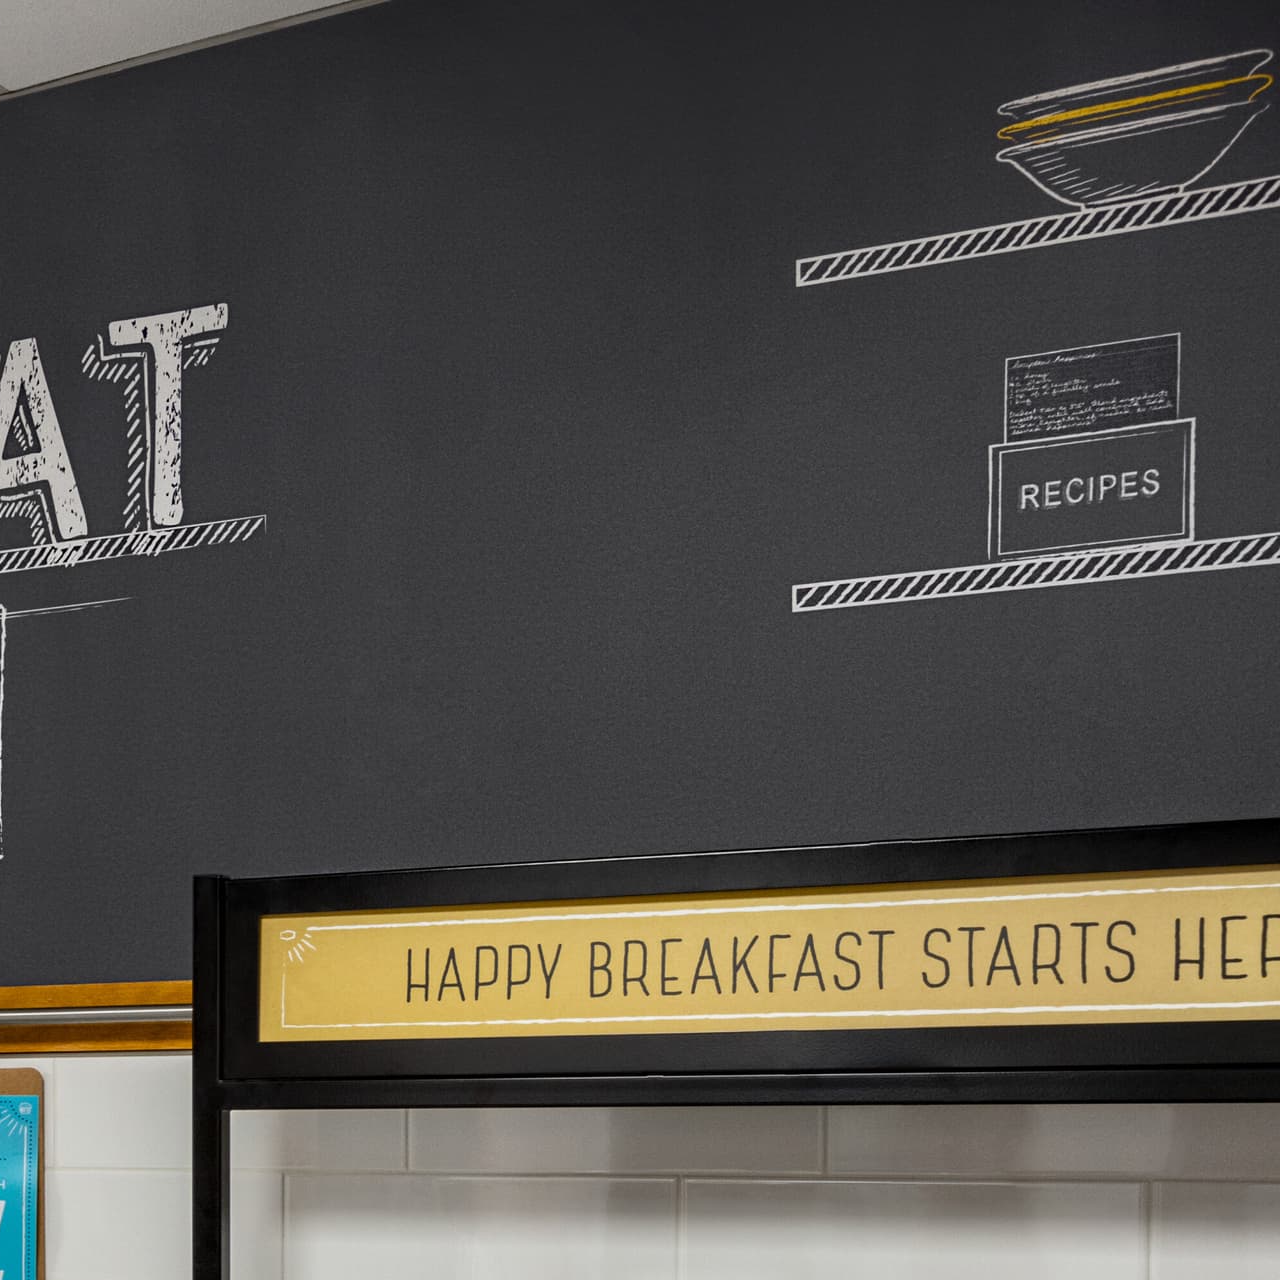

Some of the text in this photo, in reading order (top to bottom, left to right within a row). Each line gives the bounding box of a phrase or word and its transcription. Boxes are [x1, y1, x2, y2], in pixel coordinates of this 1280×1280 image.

[1018, 468, 1160, 511] RECIPES
[406, 944, 562, 1003] HAPPY
[590, 930, 895, 998] BREAKFAST
[922, 920, 1136, 989] STARTS
